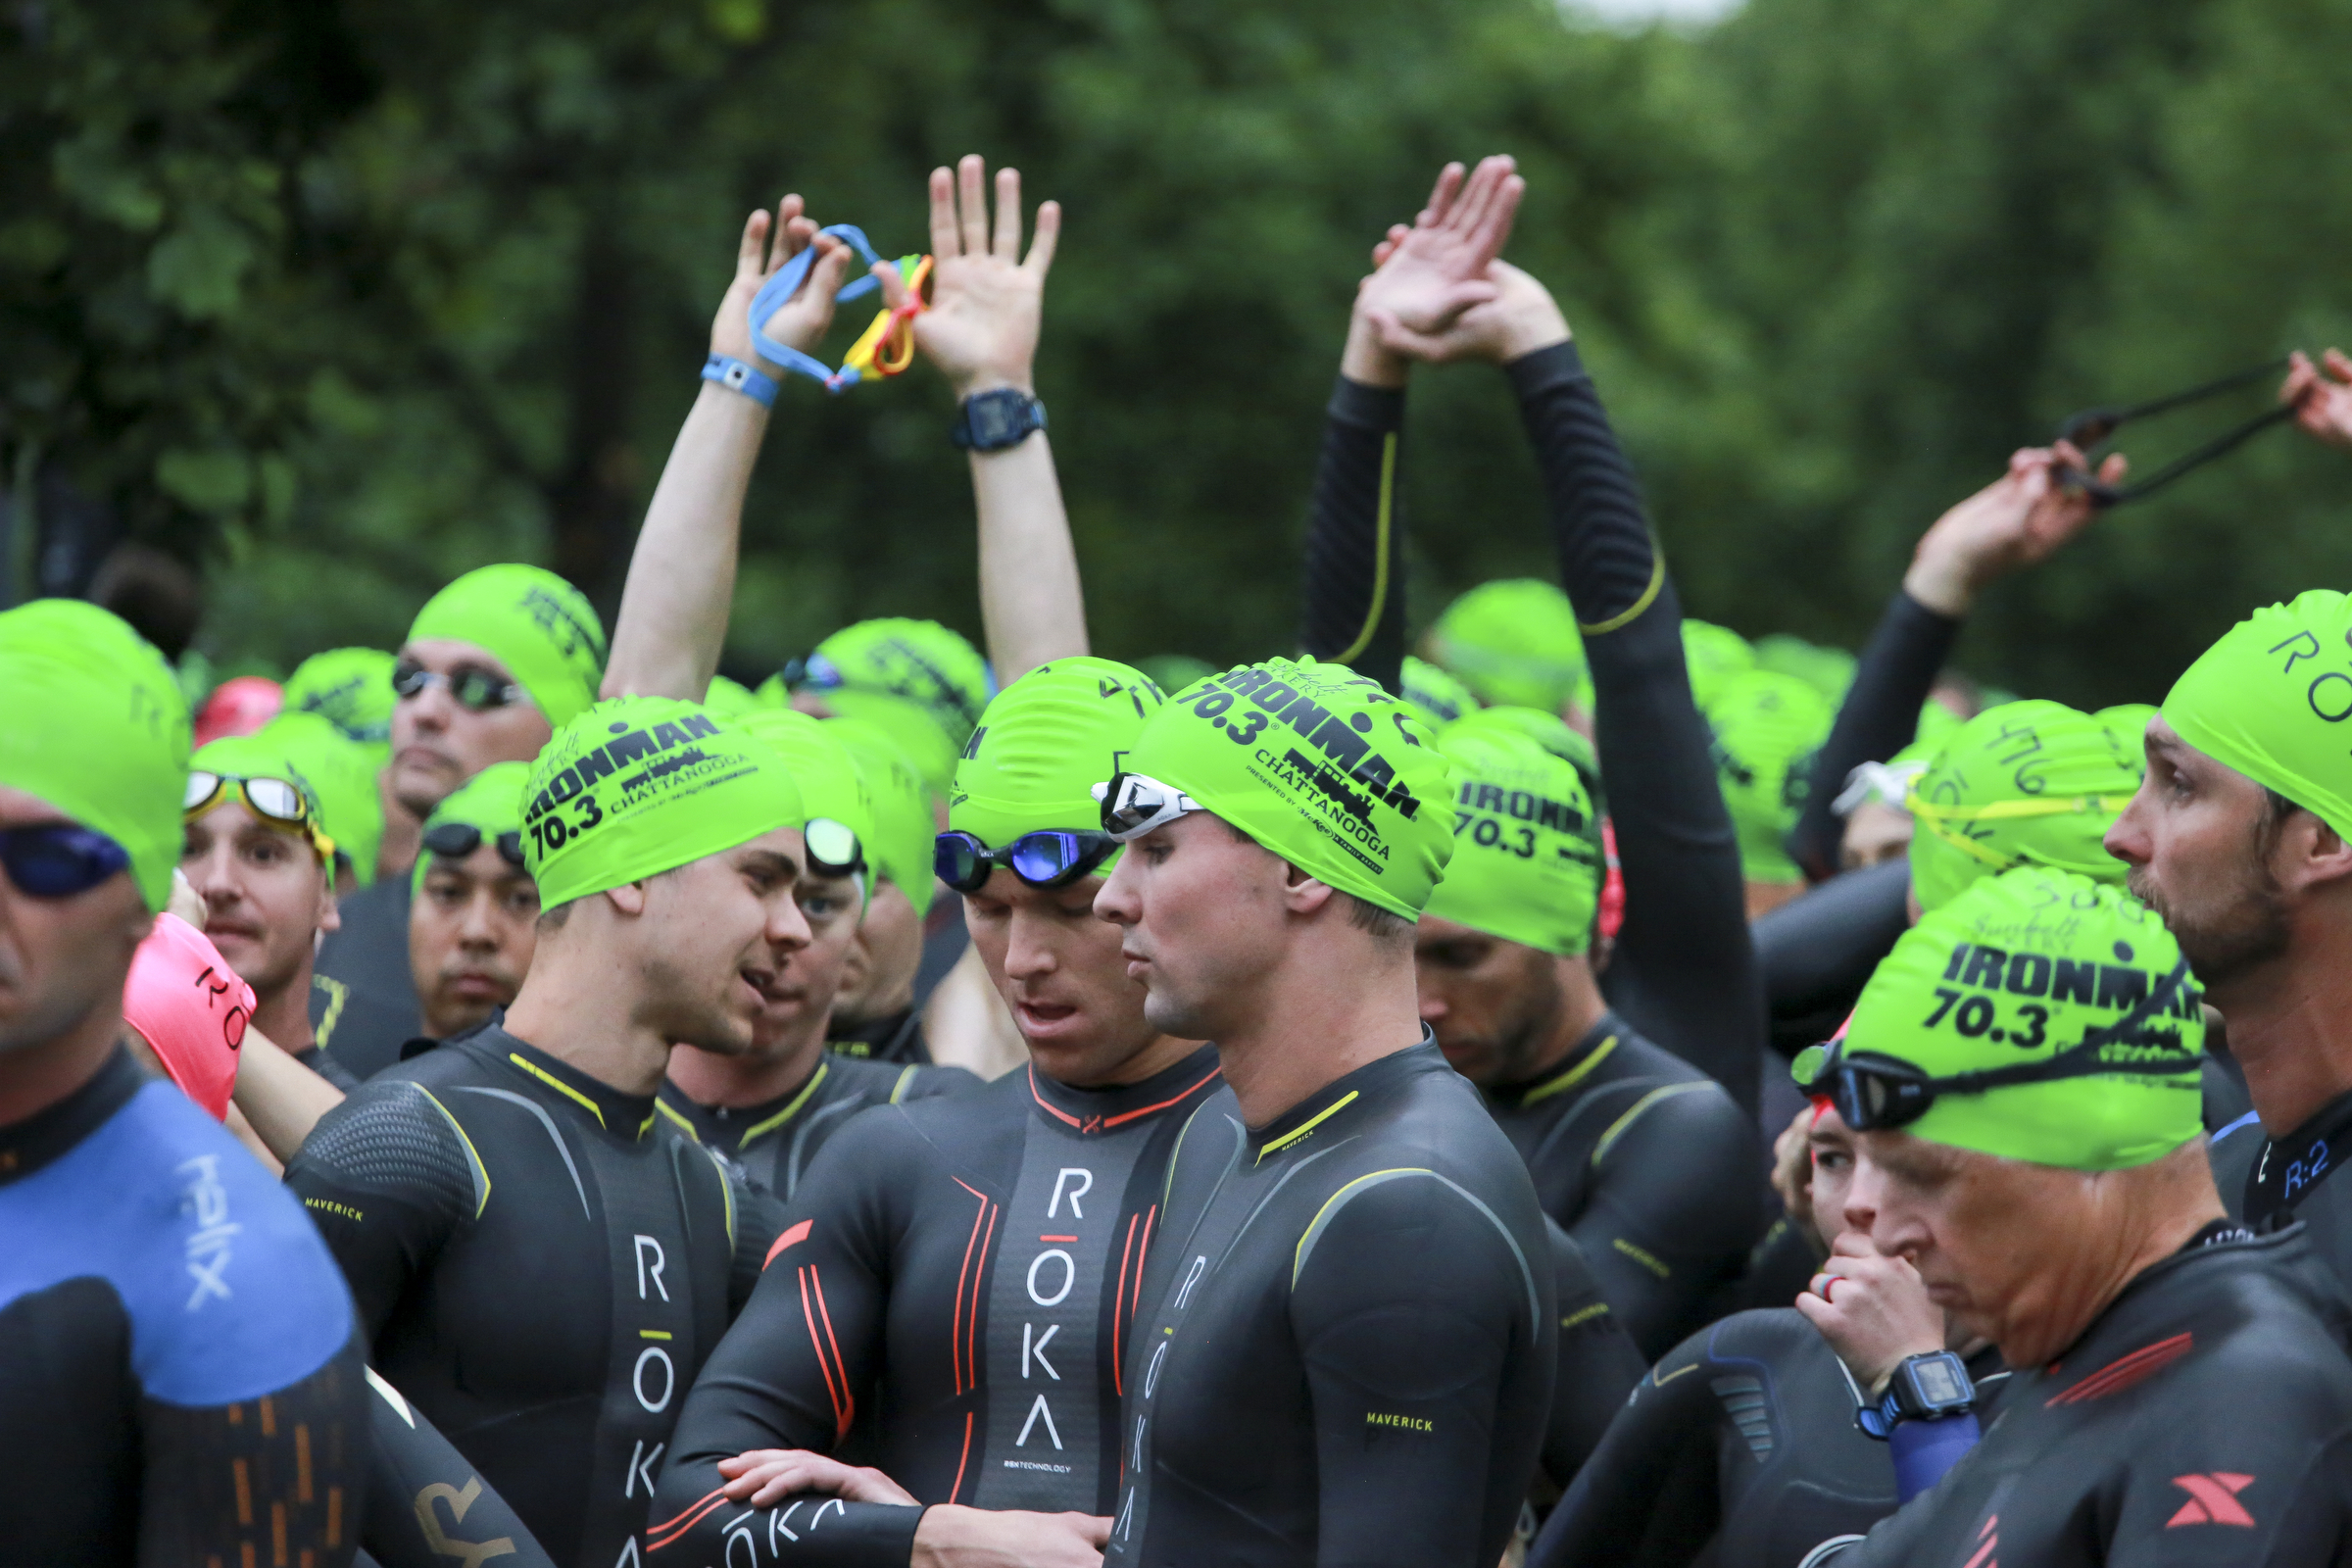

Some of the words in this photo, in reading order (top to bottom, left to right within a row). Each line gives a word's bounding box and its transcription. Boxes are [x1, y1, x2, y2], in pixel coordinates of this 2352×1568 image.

[1176, 683, 1268, 746] 70.3
[1216, 669, 1421, 819] IRONMAN
[611, 754, 751, 814] CHATTANOOGA
[1245, 764, 1287, 799] PRESENTED
[1285, 797, 1297, 807] BY
[1254, 748, 1390, 860] CHATTANOOGA
[529, 796, 604, 862] 70.3
[1453, 811, 1536, 858] 70.3
[1923, 987, 2049, 1050] 70.3
[1281, 1129, 1314, 1152] MAVERICK
[305, 1197, 364, 1222] MAVERICK
[1366, 1411, 1433, 1432] MAVERICK
